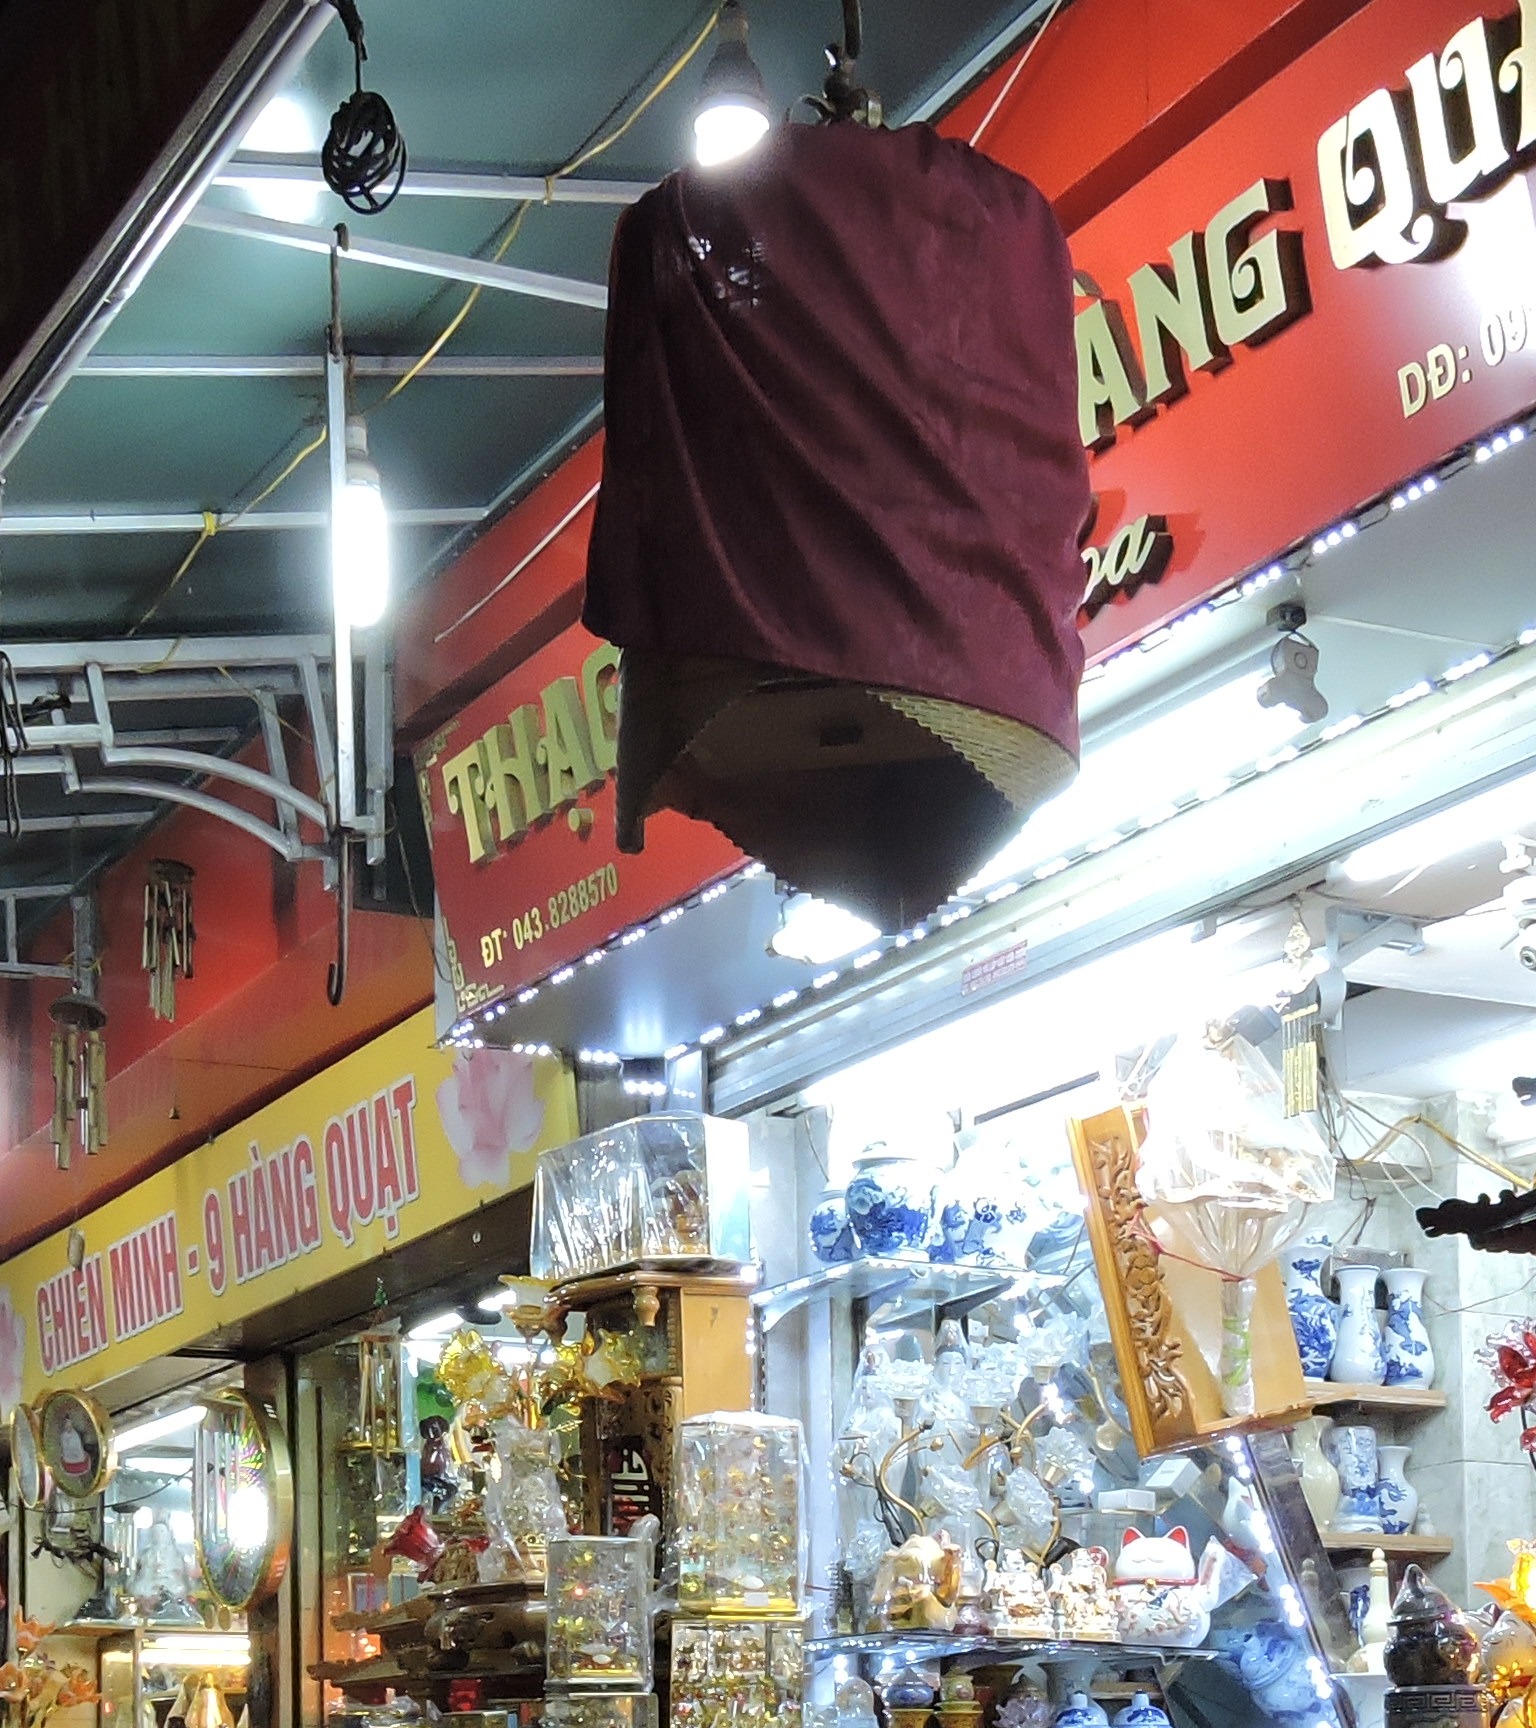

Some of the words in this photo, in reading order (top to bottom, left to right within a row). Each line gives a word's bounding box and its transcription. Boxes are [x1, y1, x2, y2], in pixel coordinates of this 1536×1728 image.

[442, 640, 618, 864] THẠC
[1073, 178, 1287, 447] ÀNG
[512, 863, 618, 951] 043.8288570
[108, 1210, 184, 1343] MINH
[202, 1187, 227, 1297] 9
[227, 1133, 323, 1284] HÀNG
[323, 1073, 421, 1247] QUẠT
